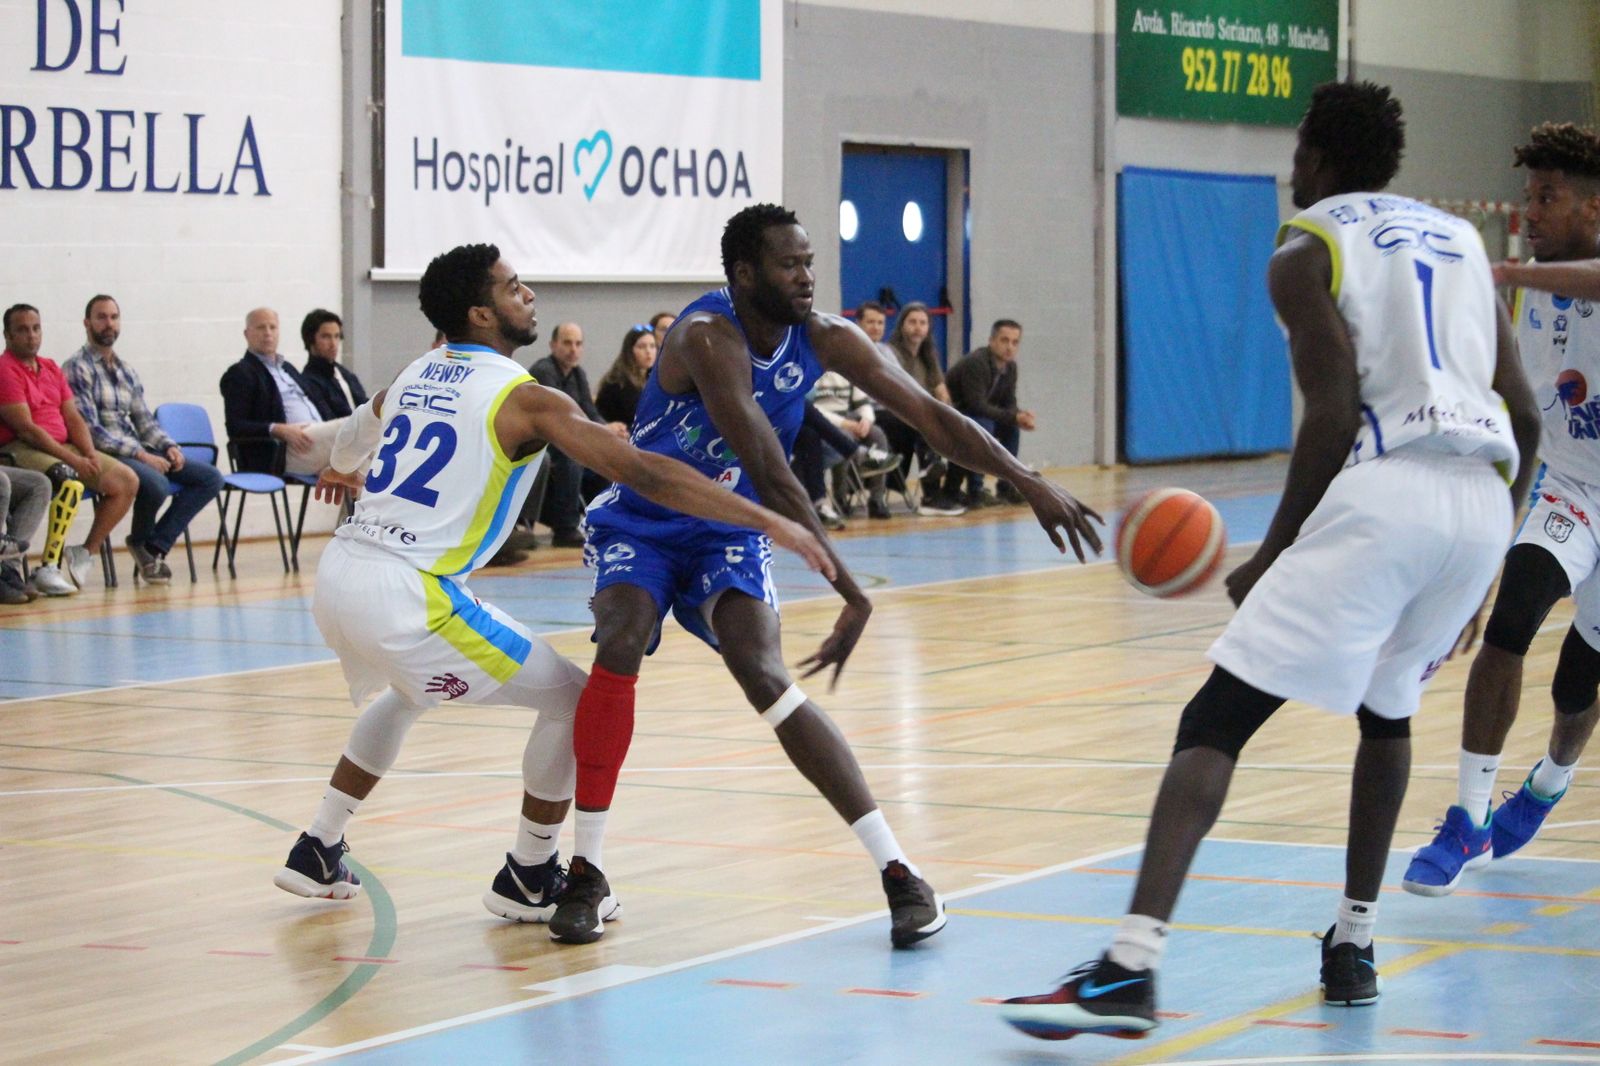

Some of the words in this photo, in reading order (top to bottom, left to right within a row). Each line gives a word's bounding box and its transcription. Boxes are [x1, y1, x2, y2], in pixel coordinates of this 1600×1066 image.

[30, 0, 128, 75] DE
[1132, 8, 1167, 34] Avda.
[1171, 11, 1215, 39] Ricardo
[1218, 17, 1264, 48] Soriano,
[1266, 22, 1279, 46] 48
[1287, 25, 1330, 51] Marbella
[1182, 47, 1218, 92] 952
[1222, 50, 1242, 94] 77
[1246, 52, 1269, 96] 28
[1271, 55, 1293, 98] 96
[413, 137, 564, 206] Hospital
[619, 145, 753, 198] OCHOA
[1413, 259, 1442, 370] 1
[419, 362, 476, 384] NEWBY
[364, 414, 458, 508] 32
